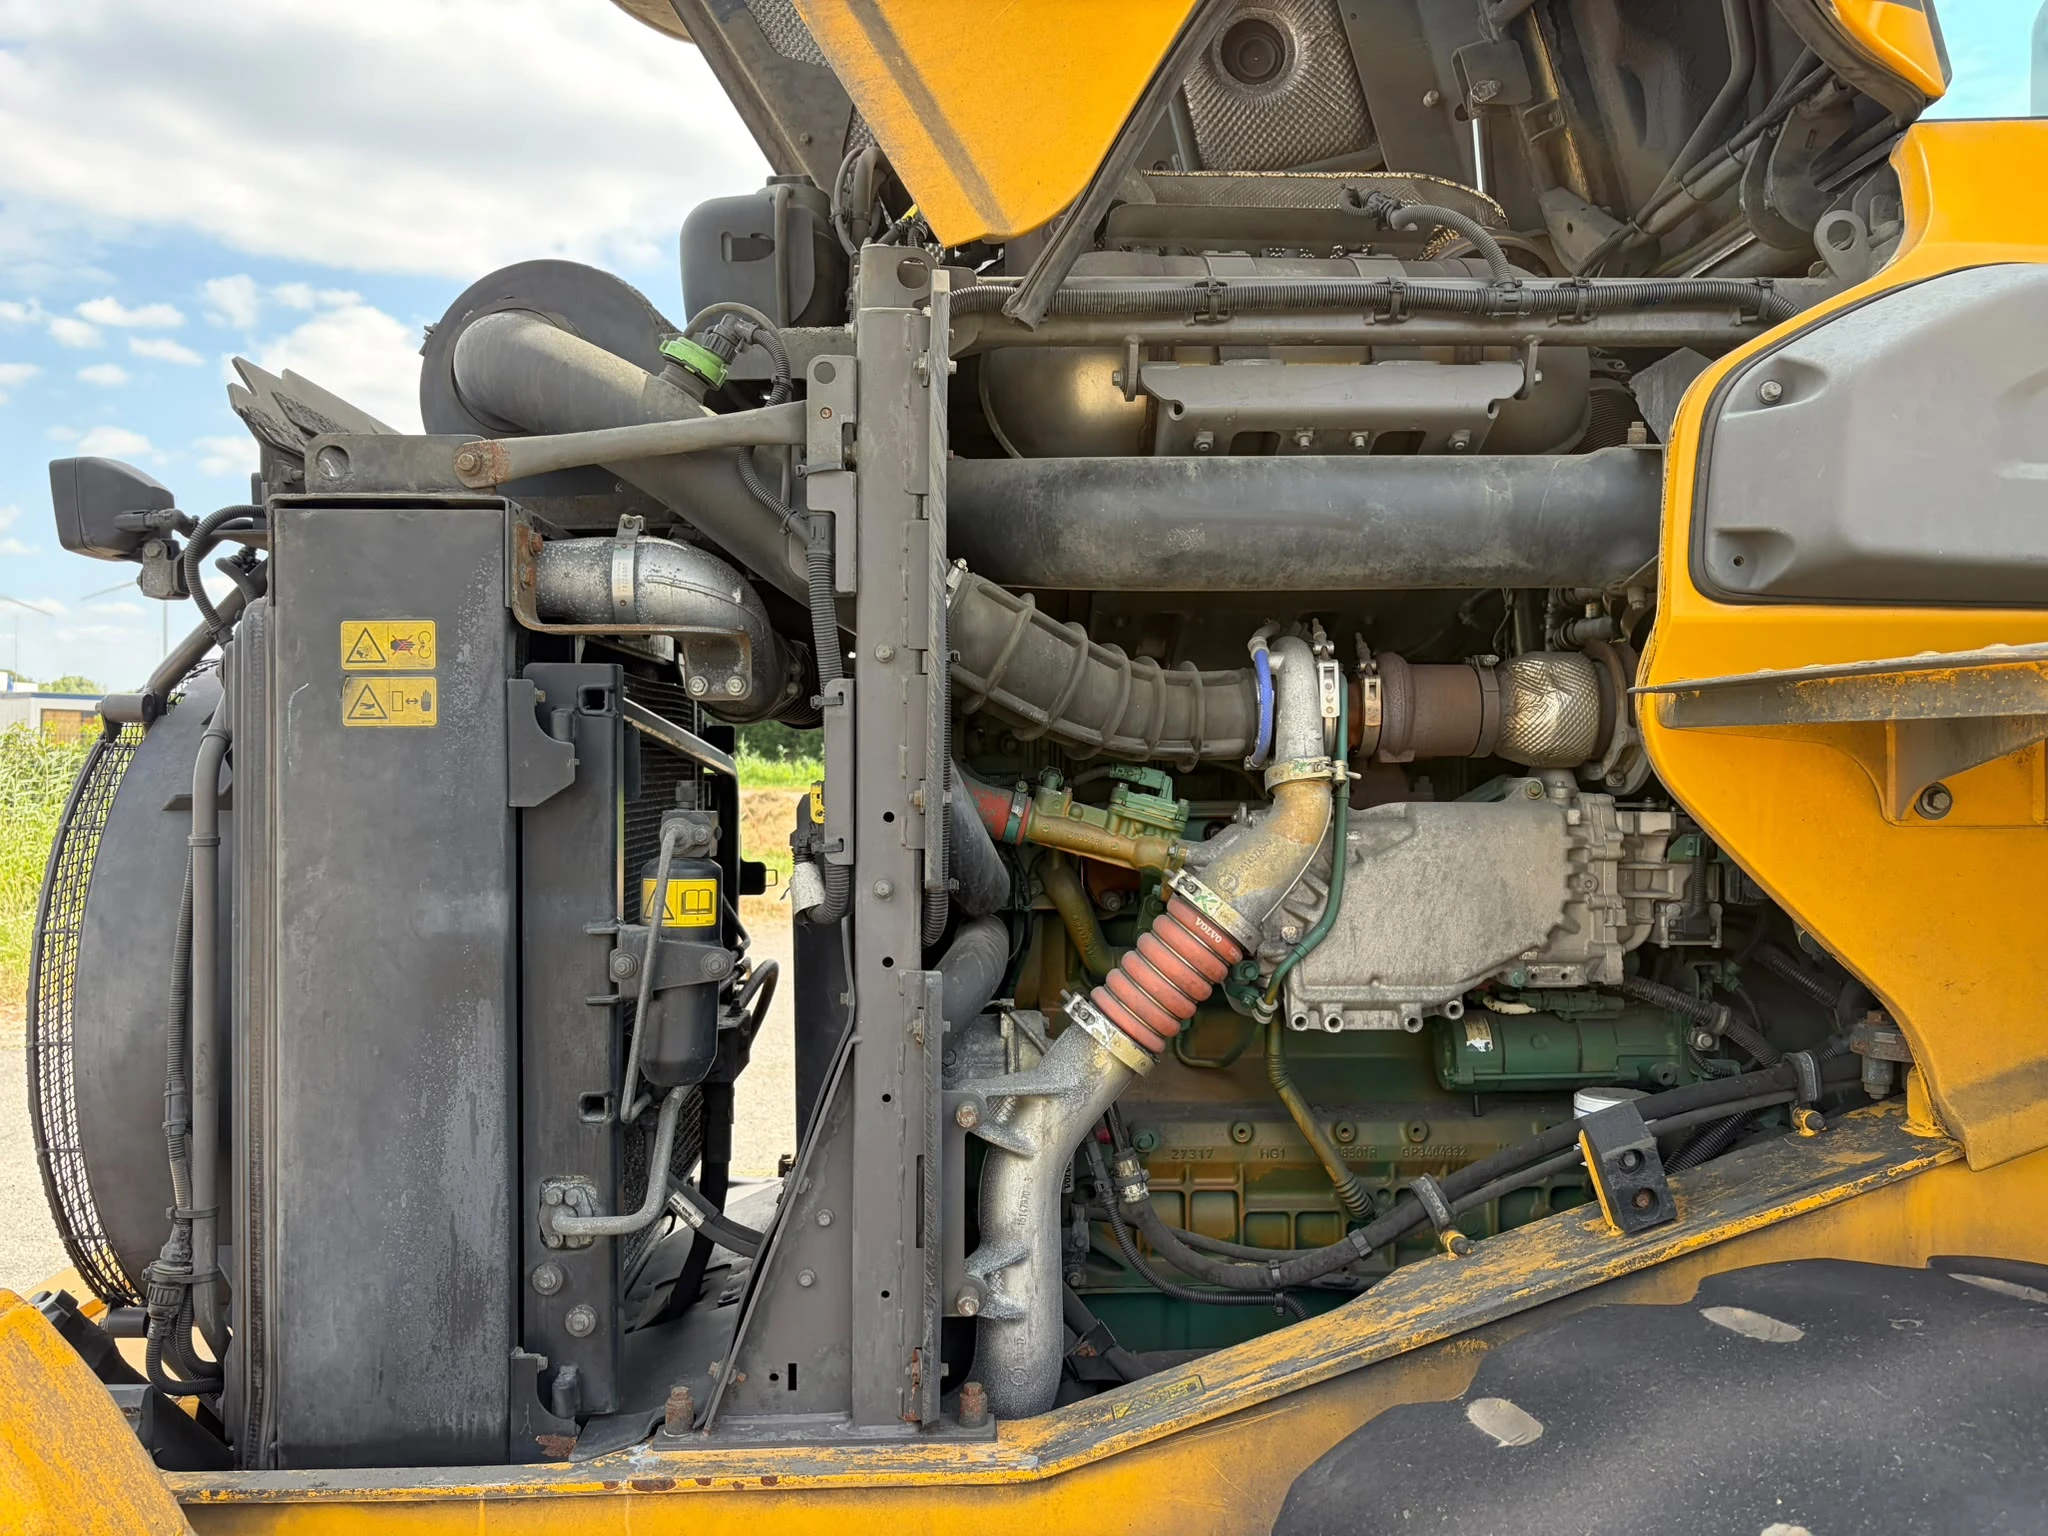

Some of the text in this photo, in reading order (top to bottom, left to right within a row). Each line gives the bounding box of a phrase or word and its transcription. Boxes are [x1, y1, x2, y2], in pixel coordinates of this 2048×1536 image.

[1194, 916, 1223, 944] VOLVO
[1171, 1148, 1215, 1160] 27317
[1260, 1147, 1287, 1160] HG1
